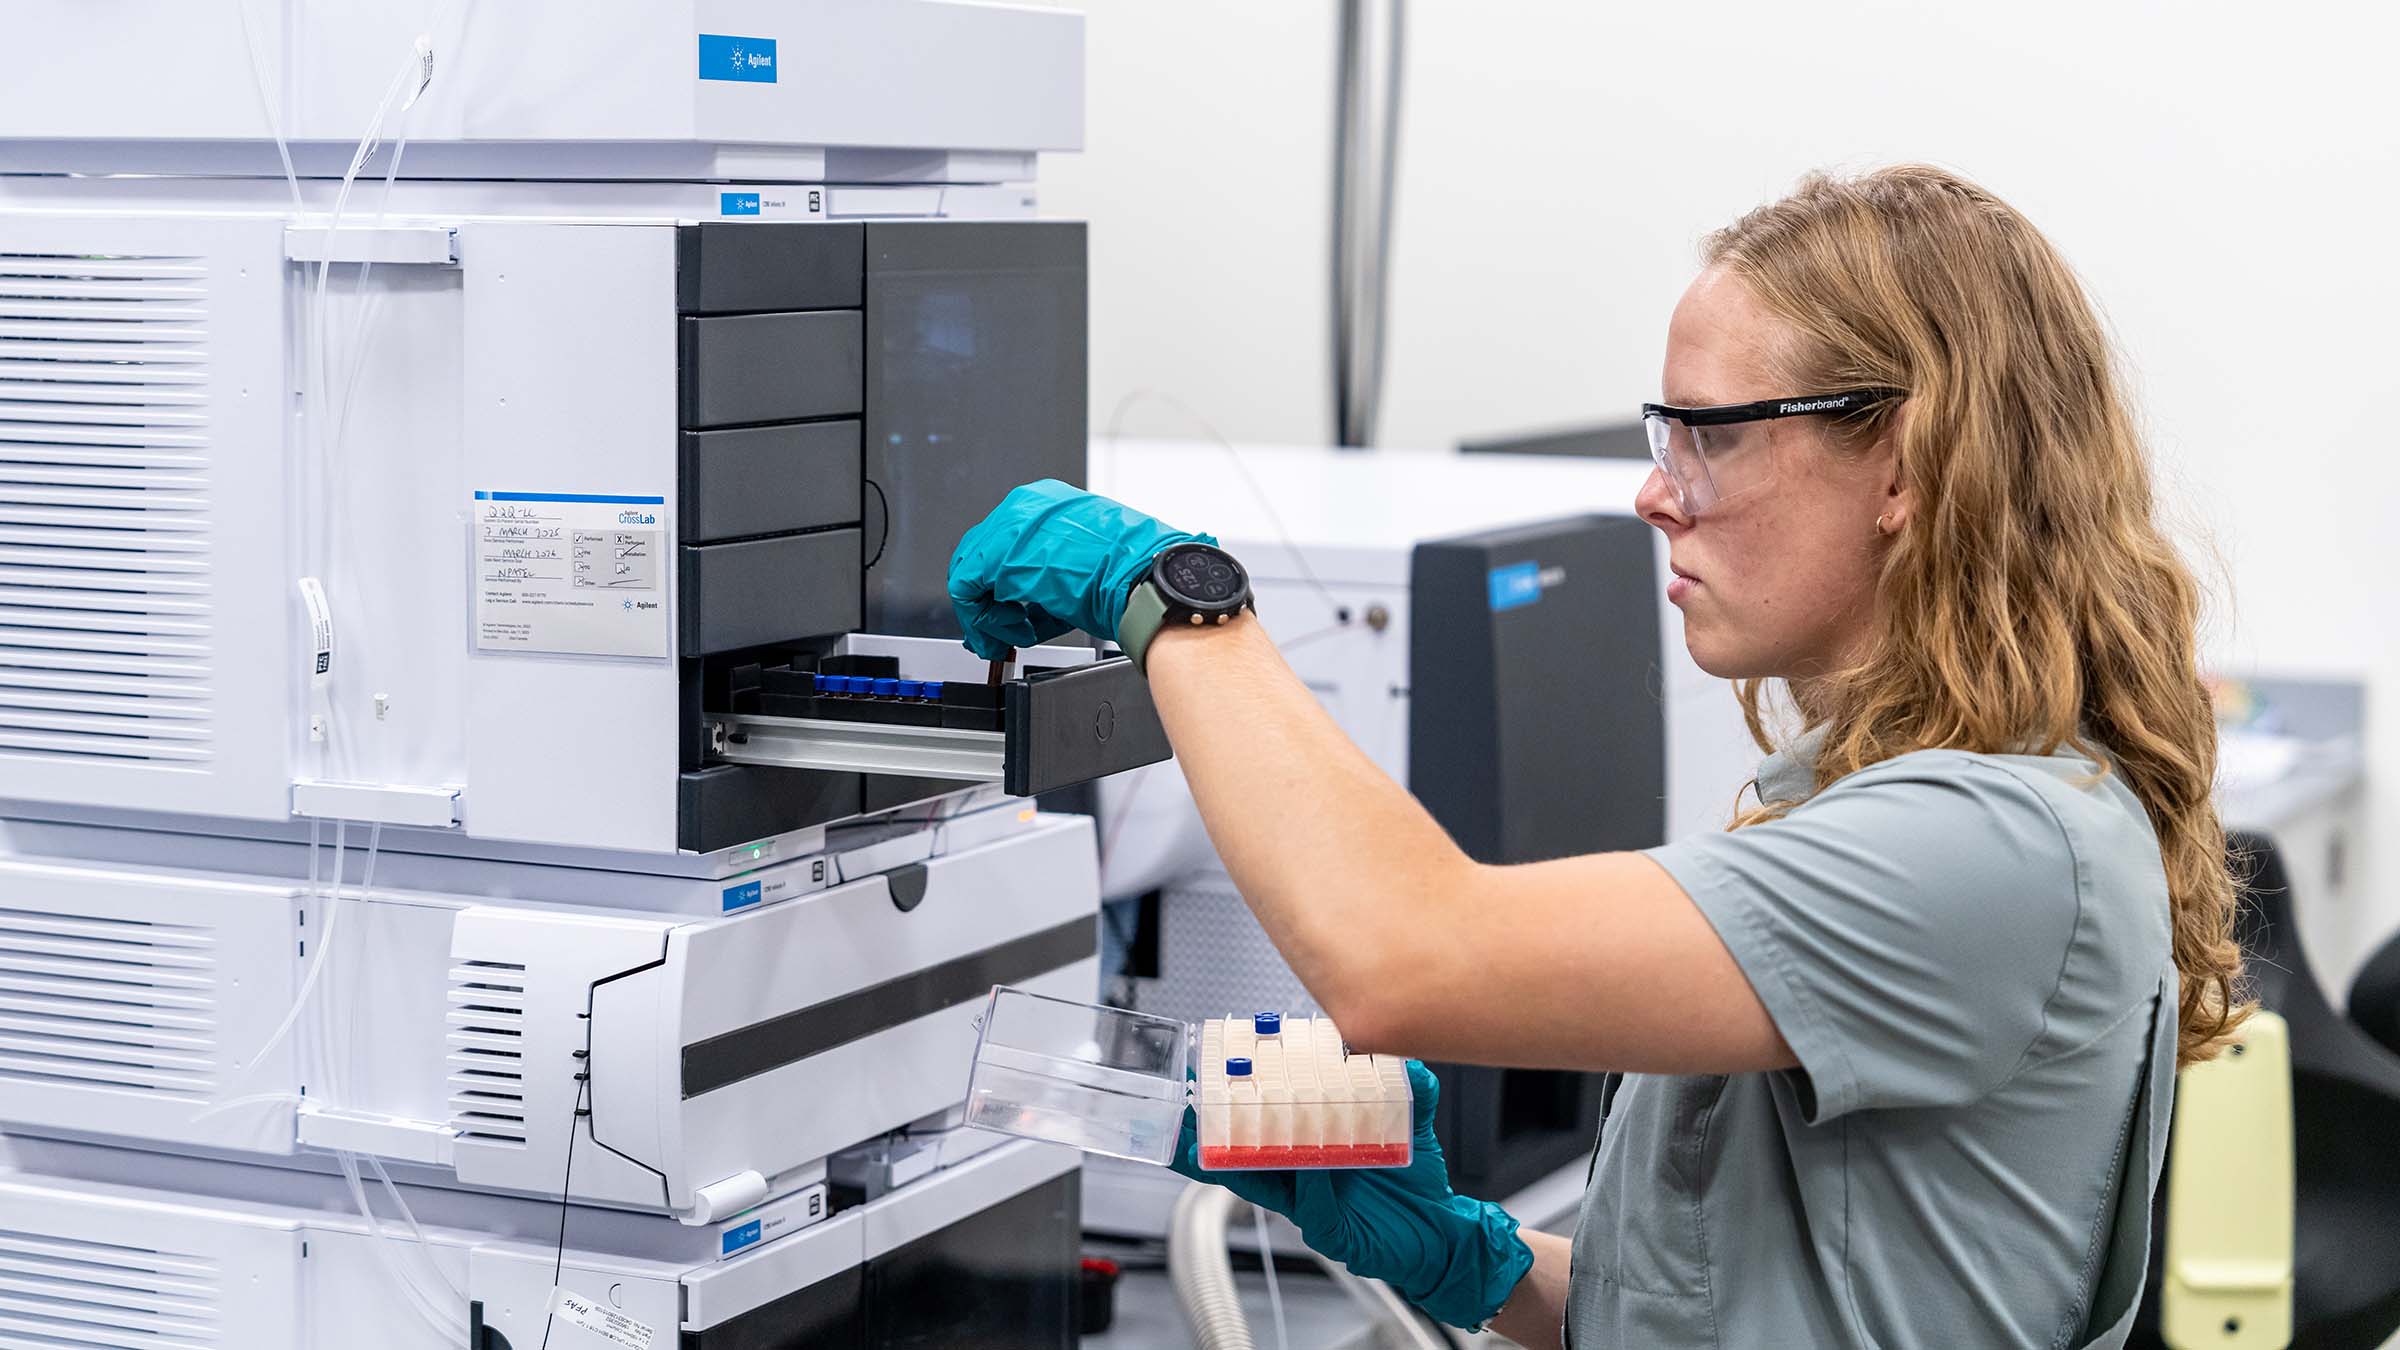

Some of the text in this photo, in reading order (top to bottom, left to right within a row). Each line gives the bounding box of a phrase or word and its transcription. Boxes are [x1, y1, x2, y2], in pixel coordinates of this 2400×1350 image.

[748, 53, 772, 68] Agilent
[618, 512, 656, 524] CrossLab
[499, 527, 528, 537] MARCH
[502, 548, 532, 559] MARCH
[637, 601, 658, 610] Agilent
